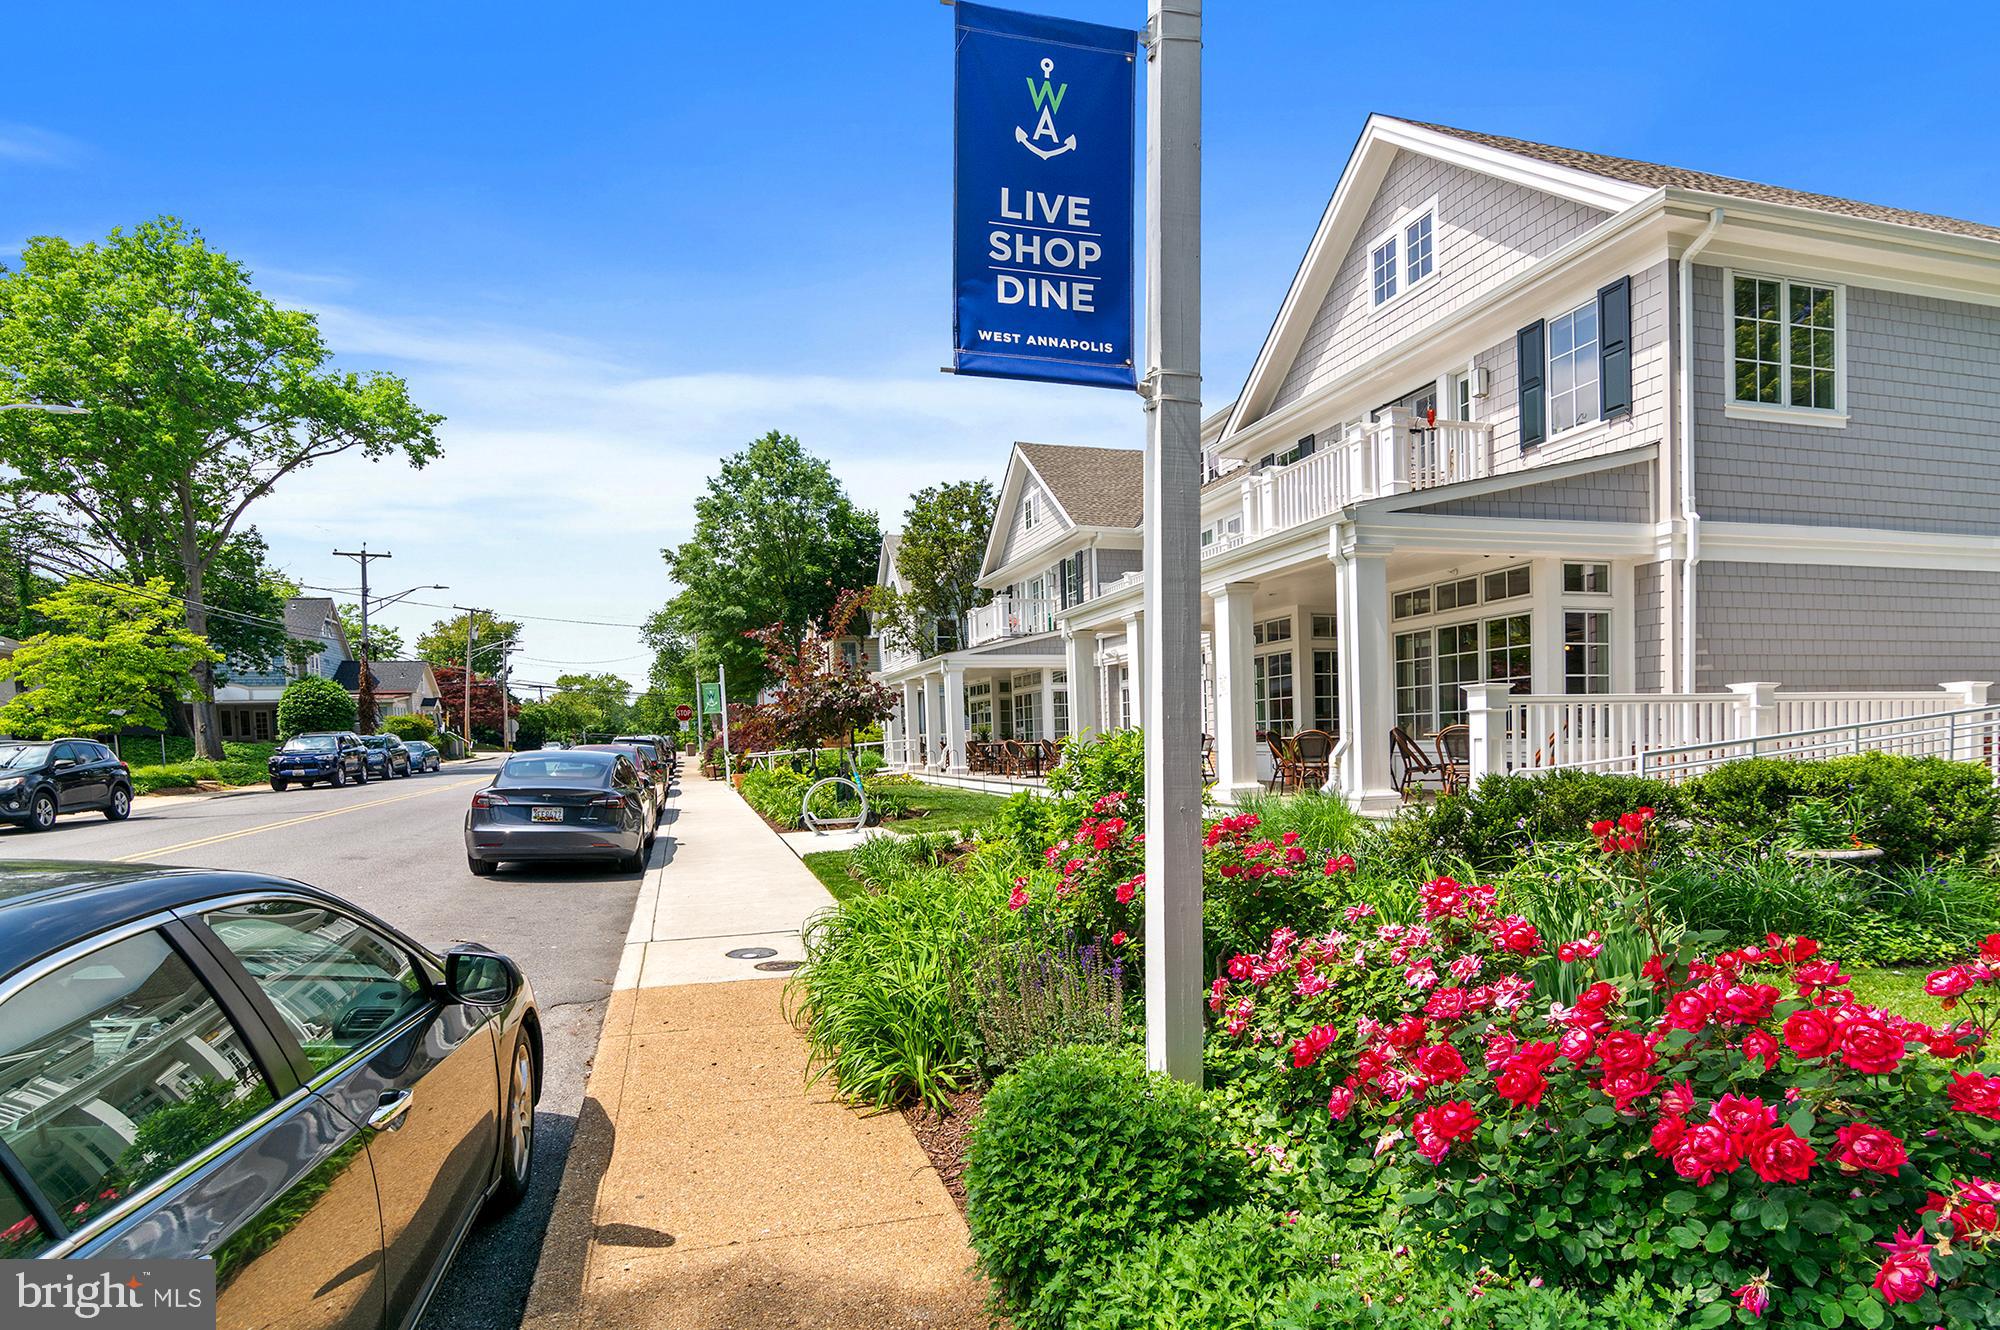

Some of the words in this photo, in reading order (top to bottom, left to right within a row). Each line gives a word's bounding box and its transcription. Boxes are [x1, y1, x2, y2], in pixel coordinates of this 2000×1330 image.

[1026, 77, 1068, 115] W
[1033, 104, 1060, 143] A
[1001, 187, 1090, 227] LIVE
[988, 230, 1102, 270] SHOP
[997, 274, 1095, 313] DINE
[978, 329, 1021, 344] WEST
[1026, 335, 1113, 353] ANNAPOLIS
